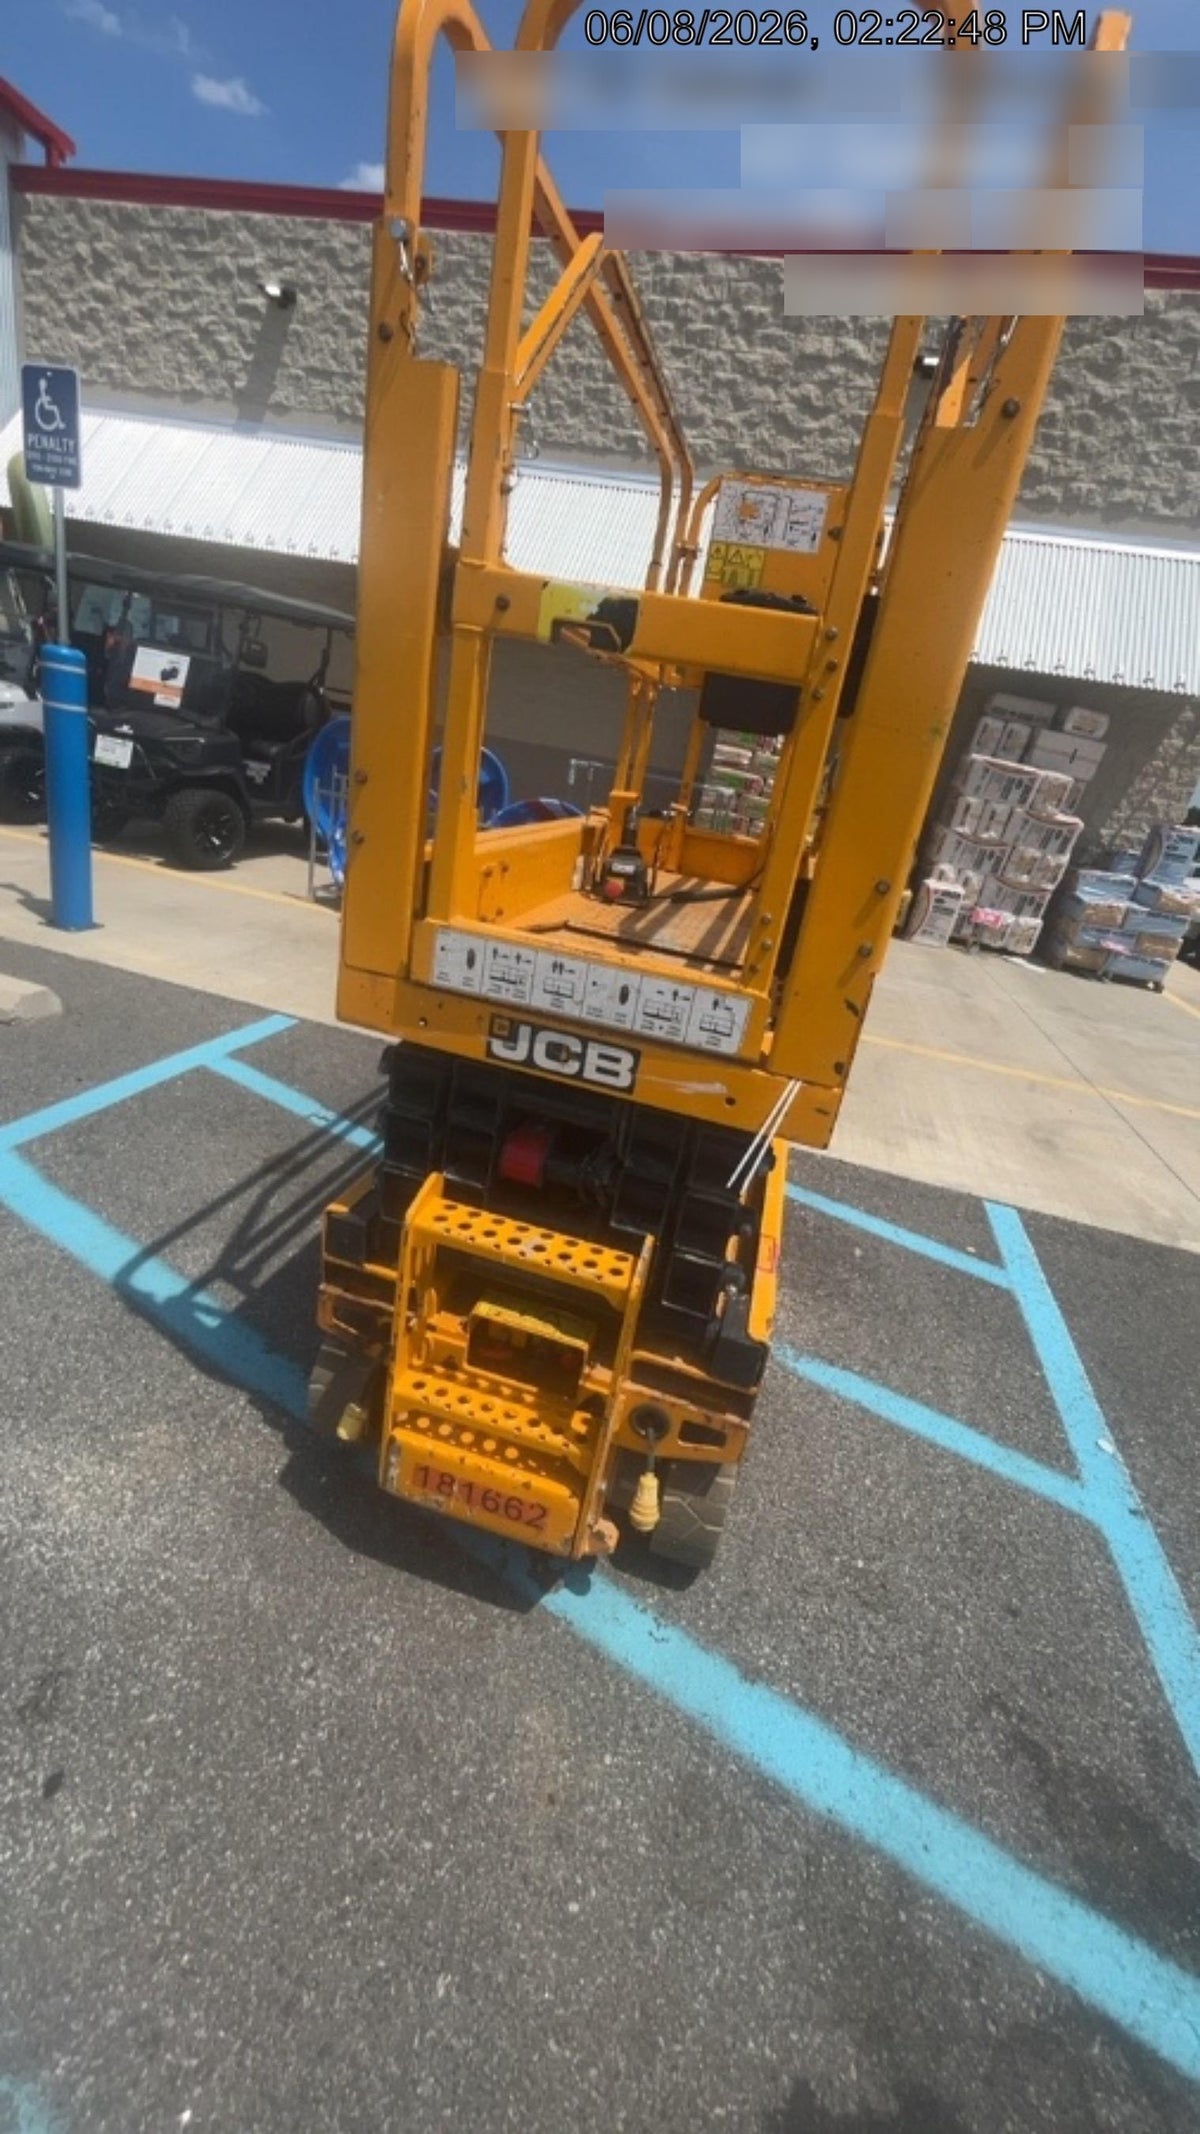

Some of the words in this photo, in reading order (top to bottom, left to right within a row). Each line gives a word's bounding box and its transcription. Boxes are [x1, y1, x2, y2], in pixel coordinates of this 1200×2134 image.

[27, 432, 76, 454] PENALTY
[490, 1023, 635, 1088] JCB
[418, 1464, 547, 1531] 181662
